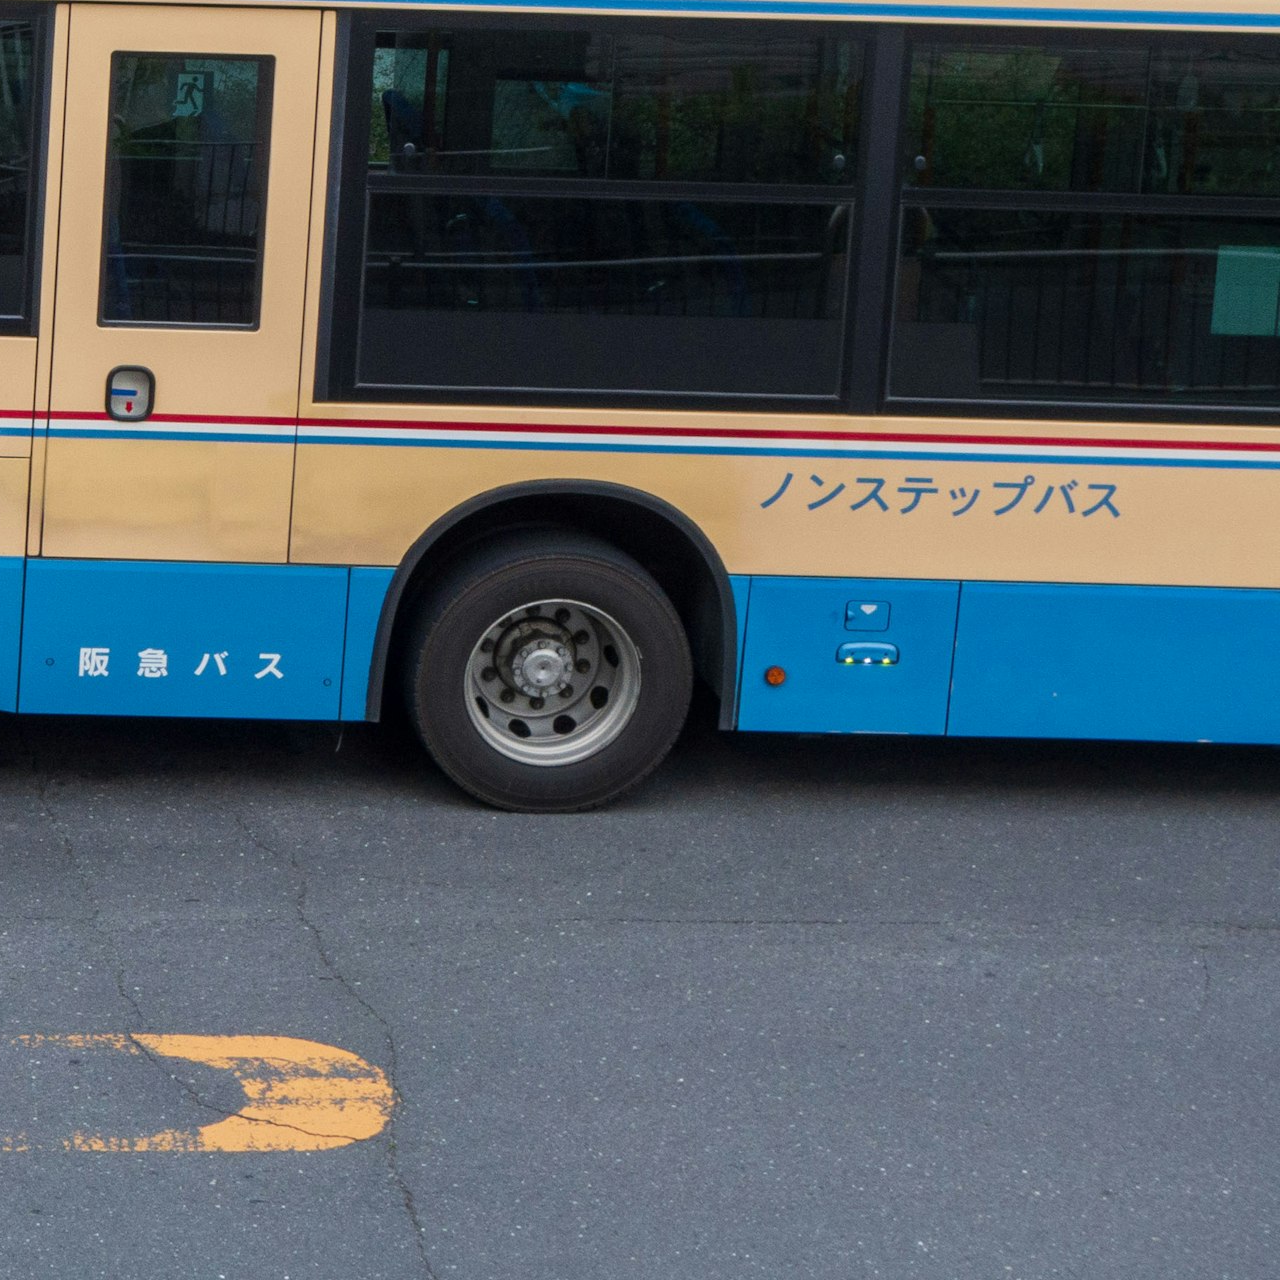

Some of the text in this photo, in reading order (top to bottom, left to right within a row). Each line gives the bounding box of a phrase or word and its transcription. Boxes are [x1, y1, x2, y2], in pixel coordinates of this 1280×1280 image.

[760, 472, 1122, 520] ノンステップバス
[78, 646, 286, 680] 阪急バス
